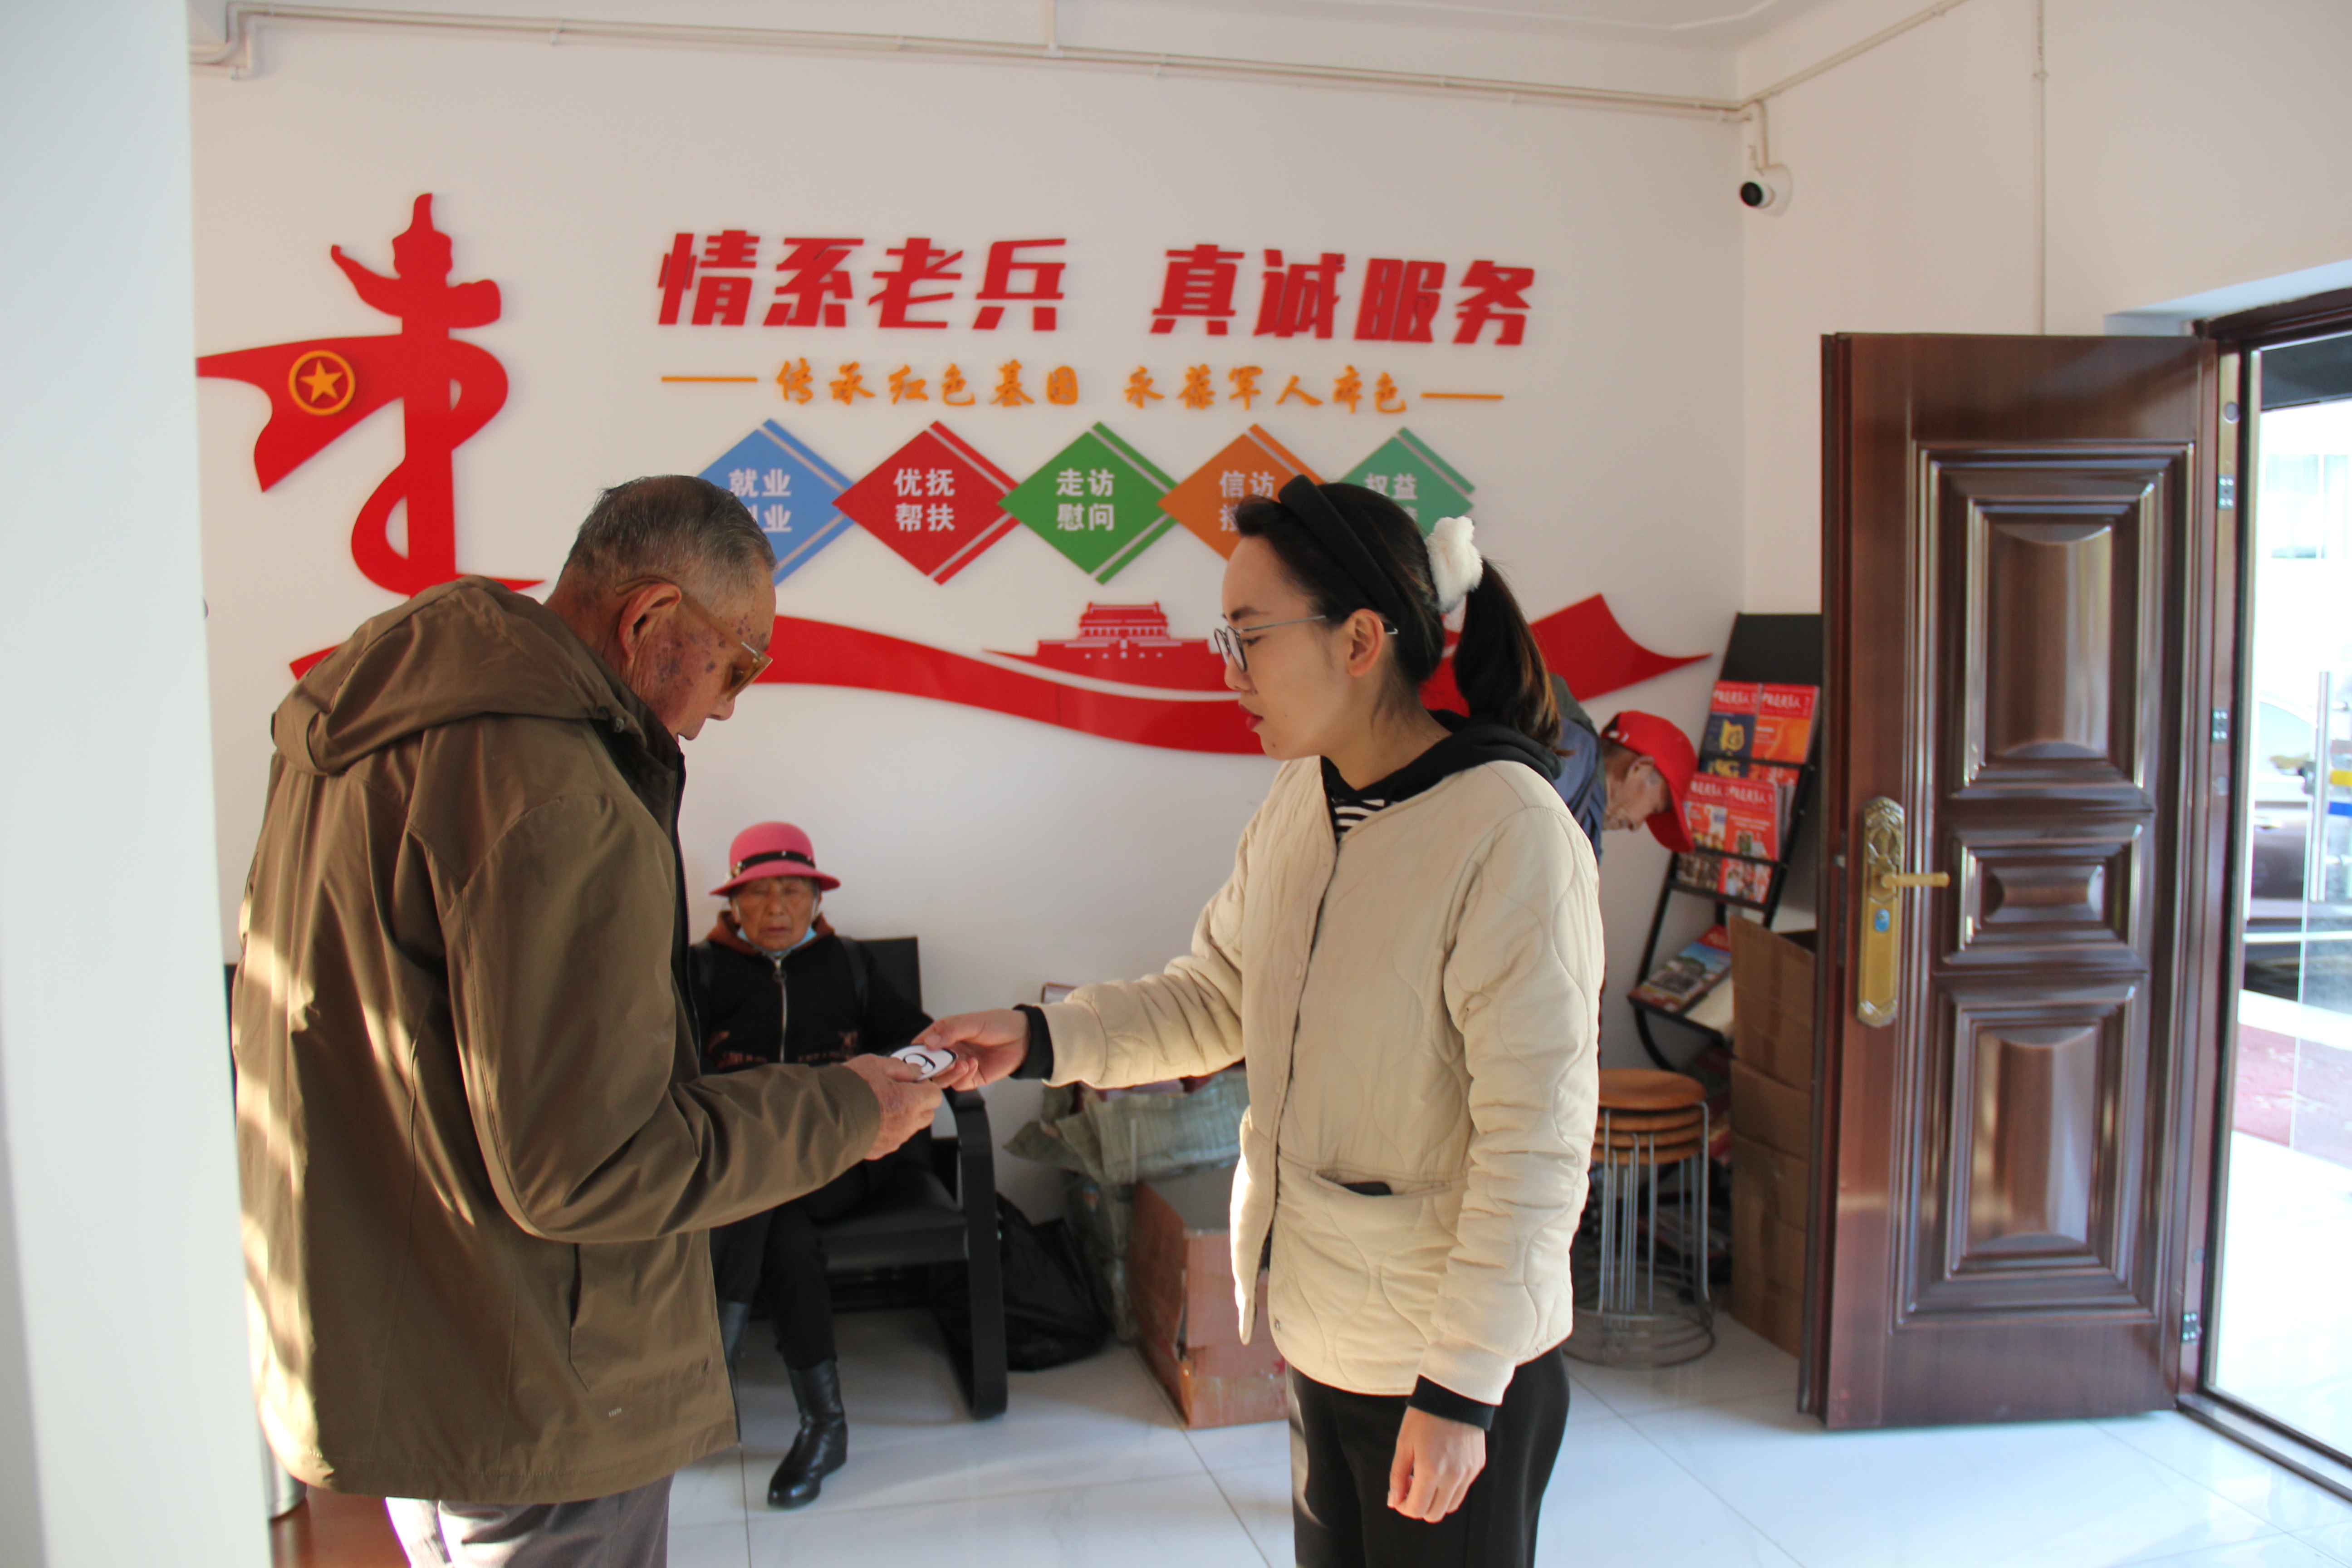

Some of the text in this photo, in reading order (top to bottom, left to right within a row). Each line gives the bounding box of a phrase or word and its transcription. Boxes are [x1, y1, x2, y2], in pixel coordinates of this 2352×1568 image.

[658, 230, 1535, 346] 情系老兵 真诚服务
[775, 357, 1407, 414] 传承红色基因 永葆军人本色
[728, 467, 792, 498] 就业
[894, 468, 955, 496] 优抚
[1056, 468, 1115, 497] 走访
[1220, 470, 1275, 498] 信访
[1364, 472, 1418, 499] 权益
[748, 504, 793, 533] 业
[896, 503, 955, 532] 帮扶
[1057, 503, 1114, 531] 慰问
